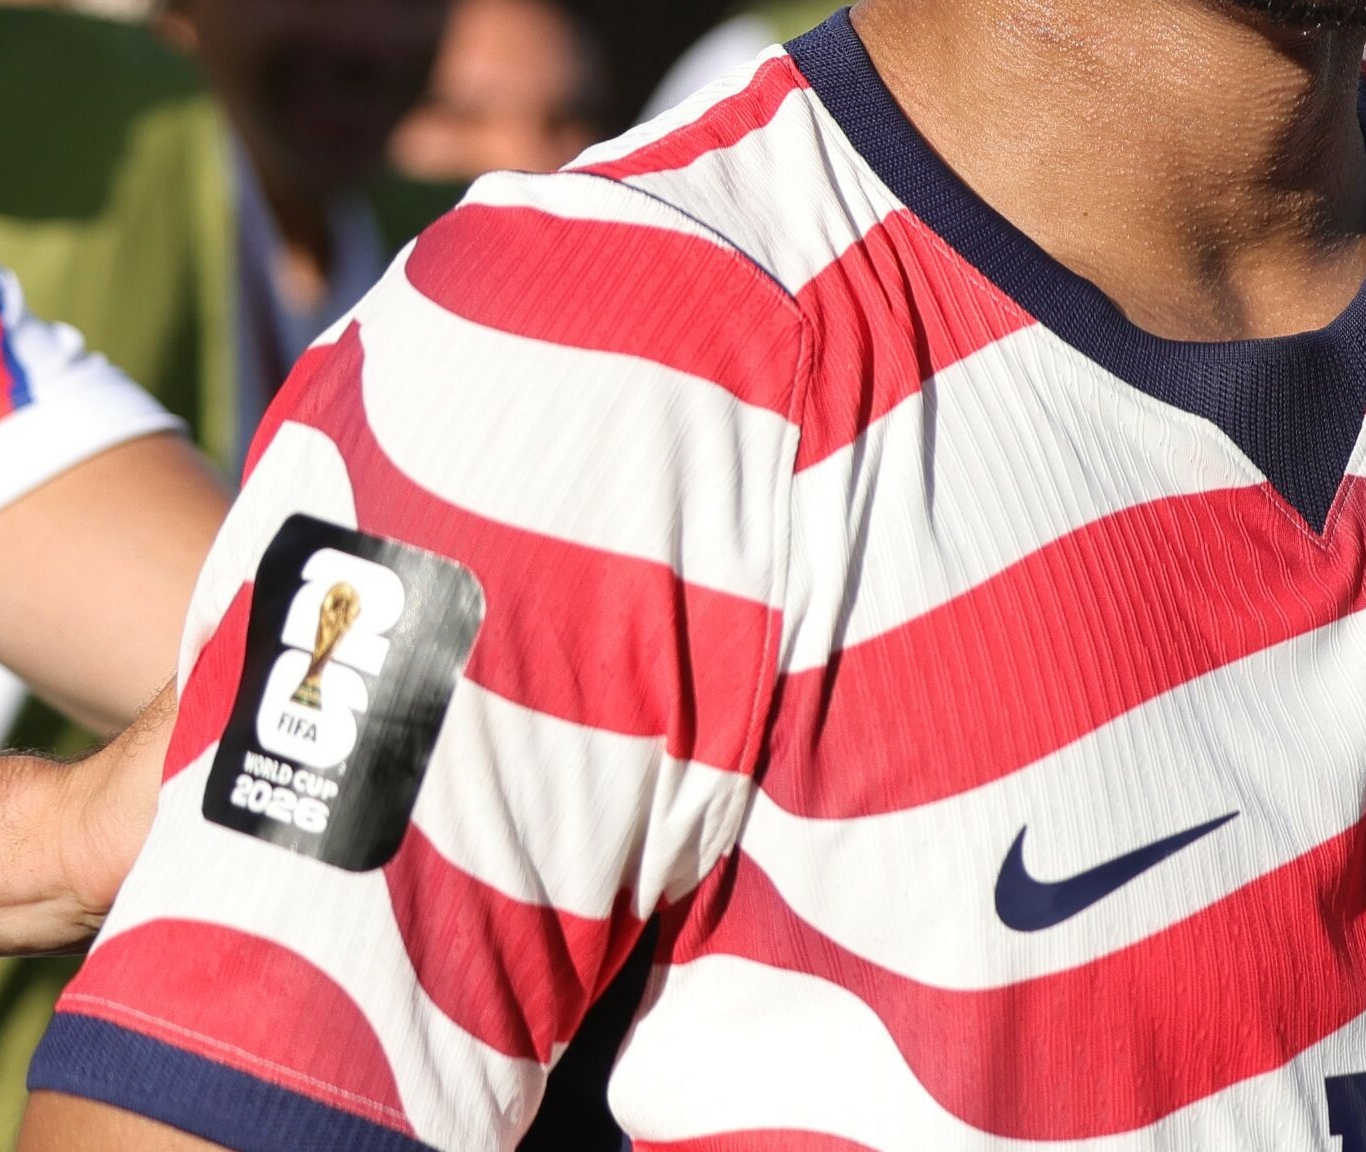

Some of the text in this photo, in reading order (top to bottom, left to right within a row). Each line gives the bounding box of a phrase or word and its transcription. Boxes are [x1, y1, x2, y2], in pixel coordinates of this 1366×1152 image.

[276, 712, 319, 743] FIFA
[244, 750, 340, 801] WORLD CUP
[230, 773, 331, 834] 2026
